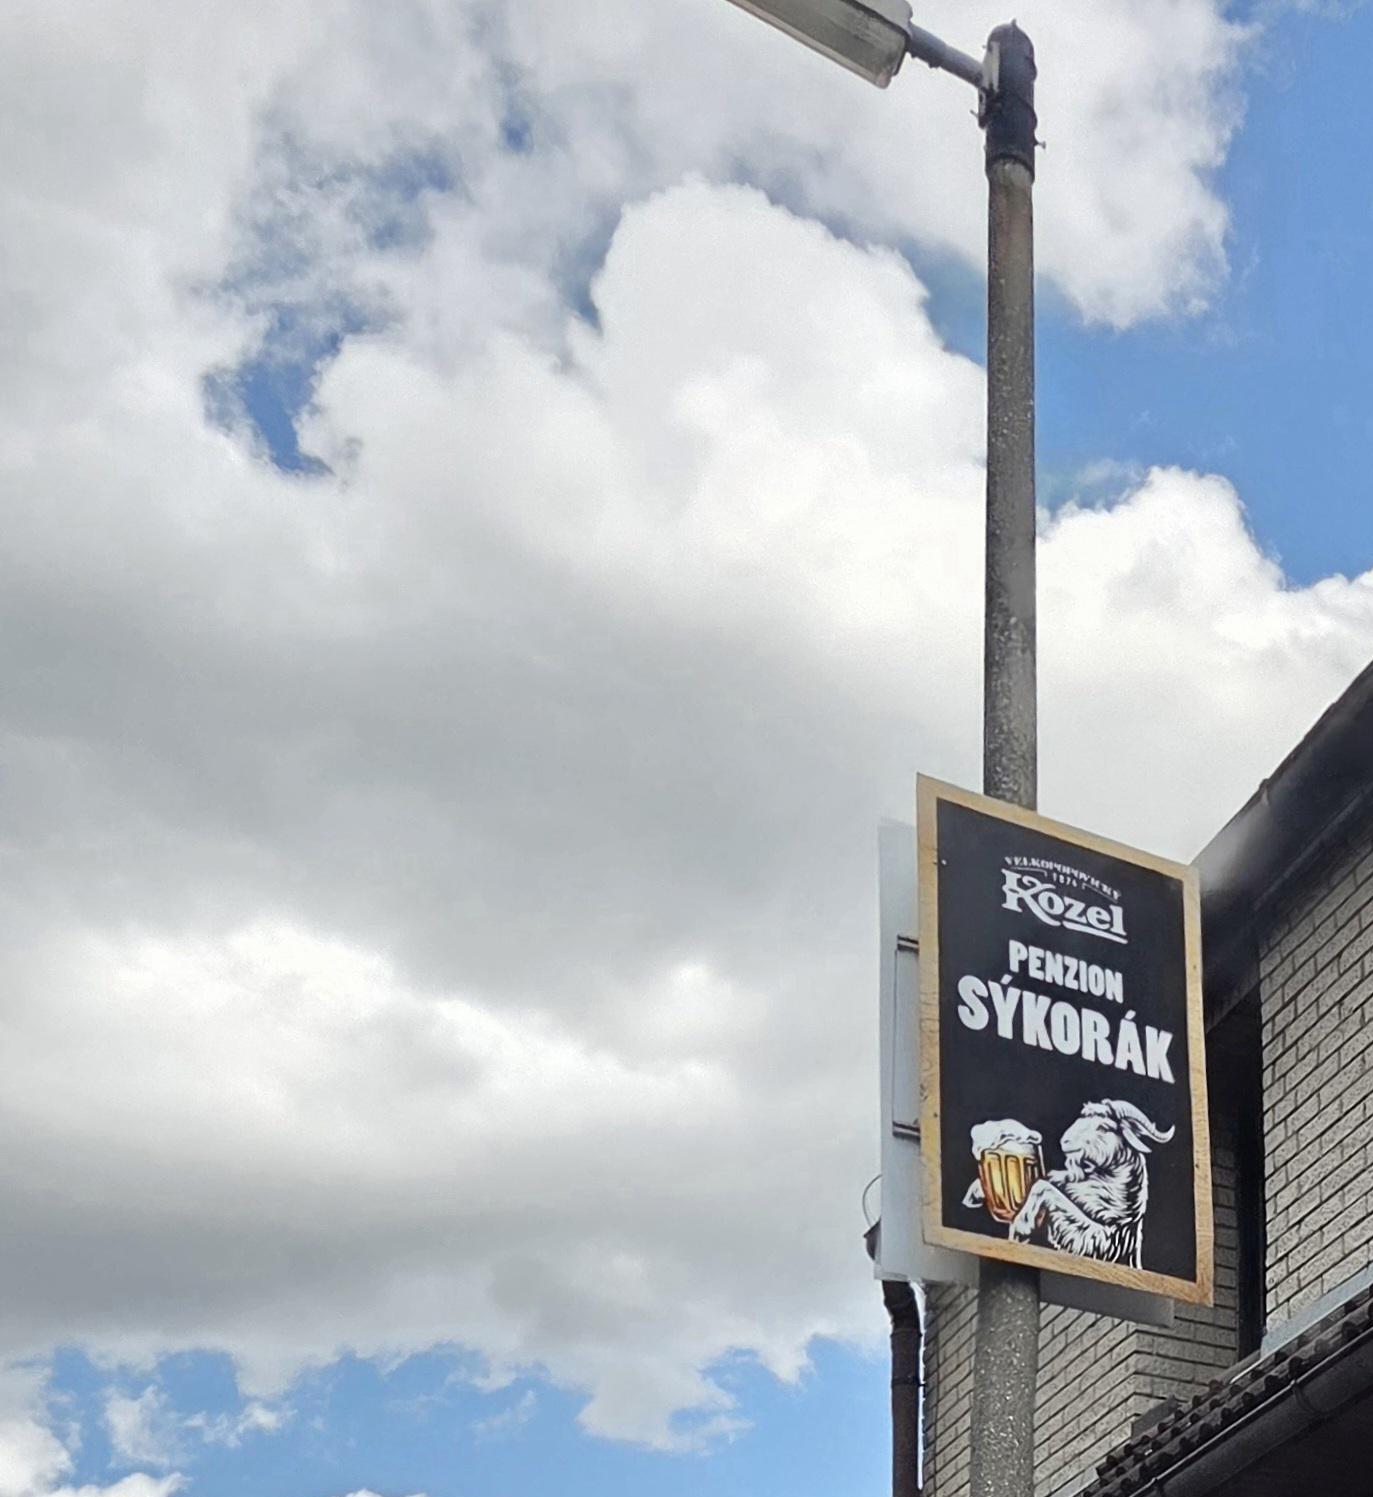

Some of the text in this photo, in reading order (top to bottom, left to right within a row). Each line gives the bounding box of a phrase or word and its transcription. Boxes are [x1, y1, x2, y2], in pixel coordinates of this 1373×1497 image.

[1001, 868, 1127, 938] Kozel
[1009, 940, 1124, 1003] PENZION
[957, 974, 1175, 1083] SÝKORÁK
